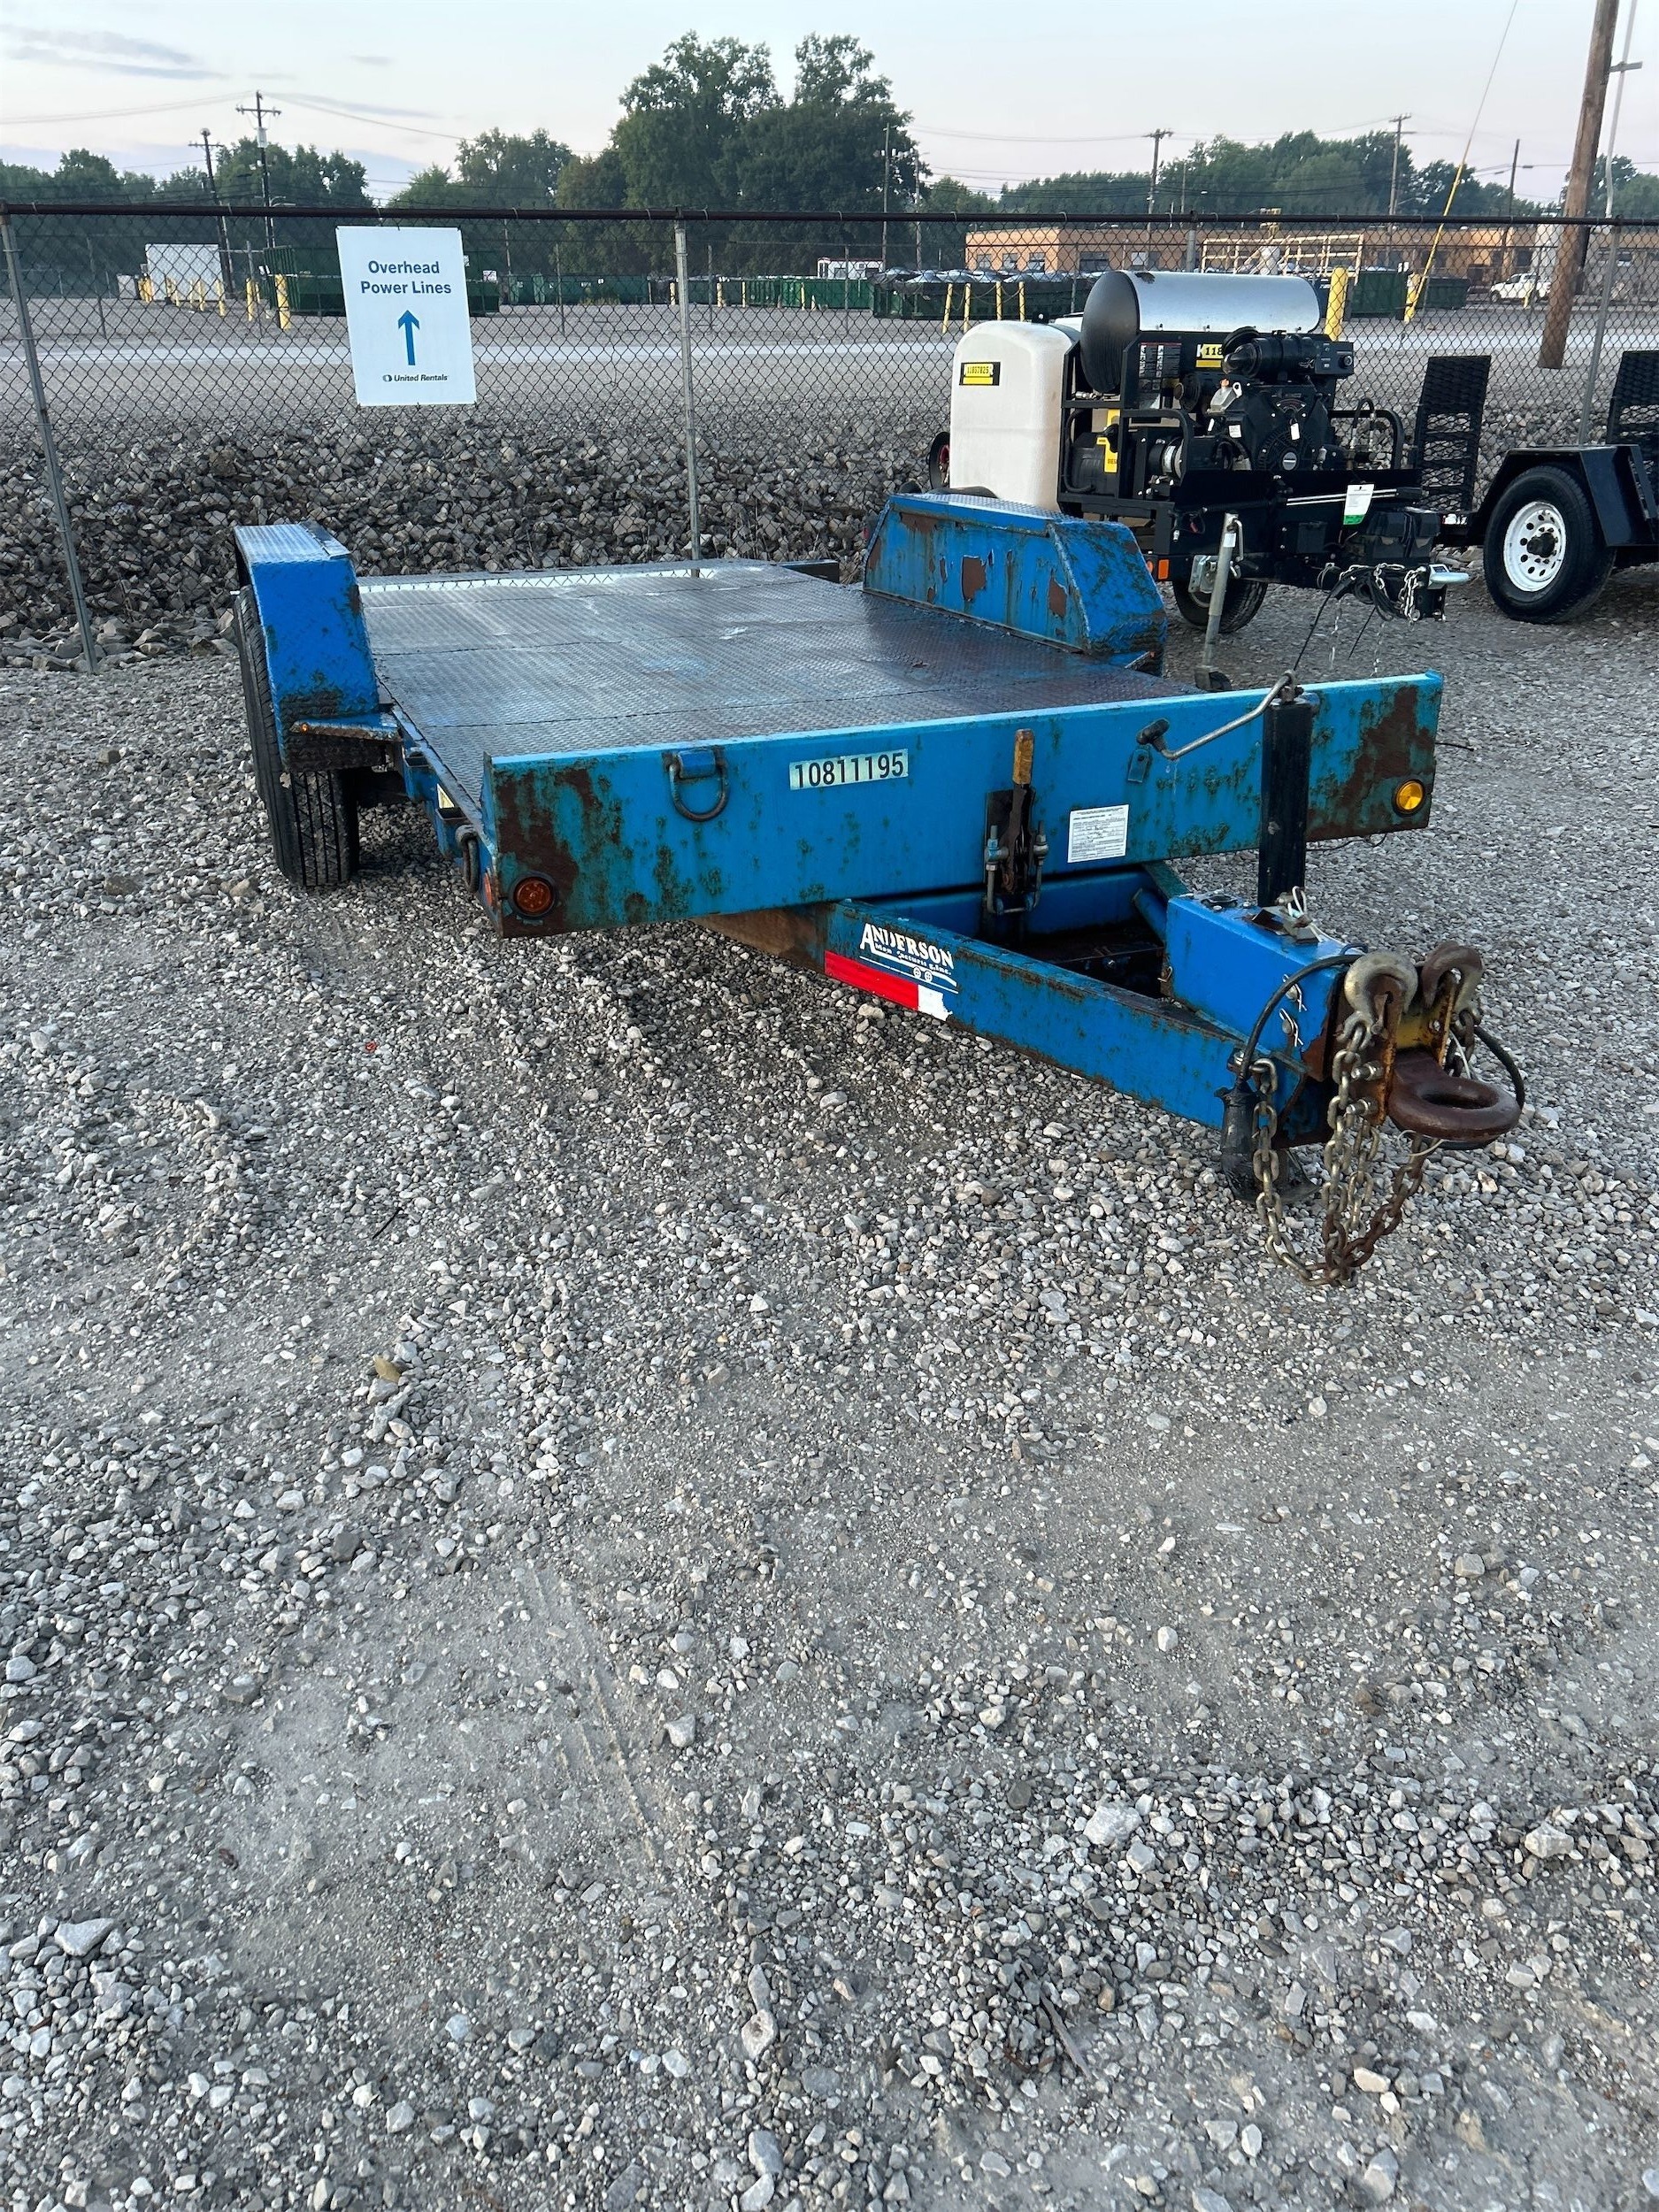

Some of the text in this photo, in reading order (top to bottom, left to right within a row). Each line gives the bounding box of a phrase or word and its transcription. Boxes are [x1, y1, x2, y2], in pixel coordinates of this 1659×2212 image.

[368, 260, 440, 274] Overhead
[361, 280, 452, 294] Power Lines
[795, 752, 903, 788] 10811195
[859, 923, 955, 970] ANDERSON
